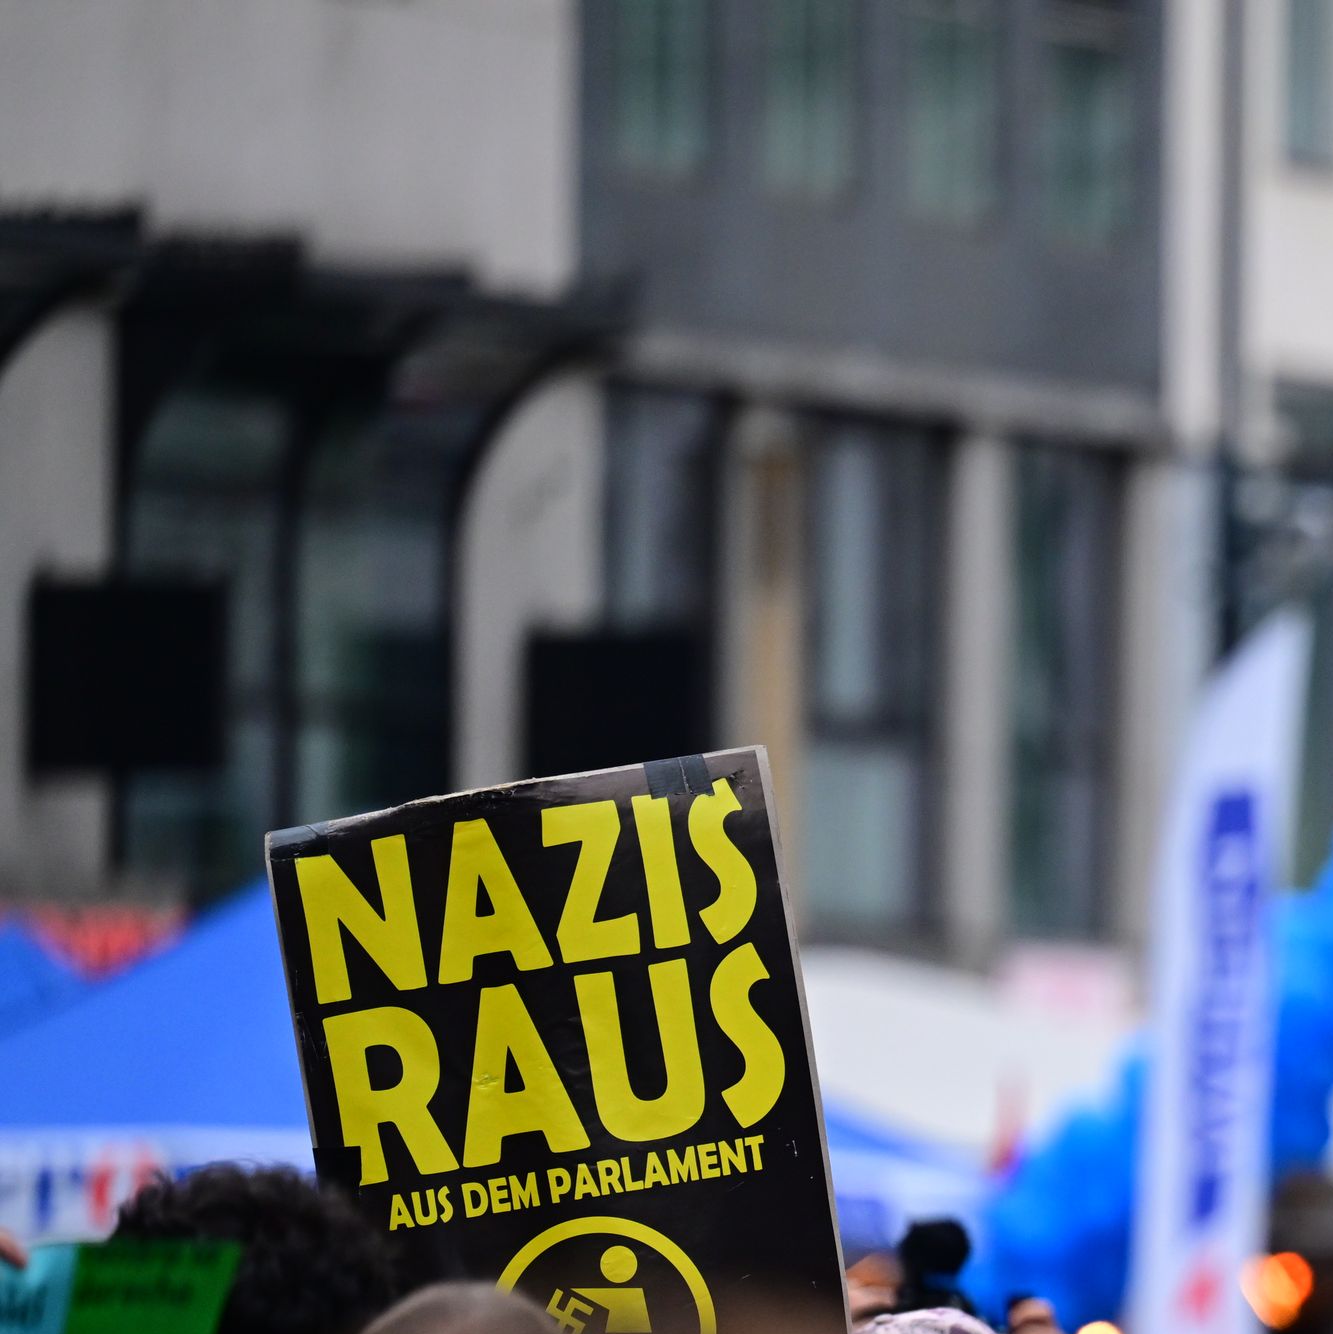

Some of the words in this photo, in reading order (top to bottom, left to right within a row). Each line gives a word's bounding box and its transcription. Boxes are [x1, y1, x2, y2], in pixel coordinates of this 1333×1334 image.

[295, 780, 757, 1004] NAZIS
[323, 942, 785, 1186] RAUS
[390, 1186, 453, 1230] AUS
[461, 1171, 541, 1218] DEM
[547, 1135, 765, 1203] PARLAMENT
